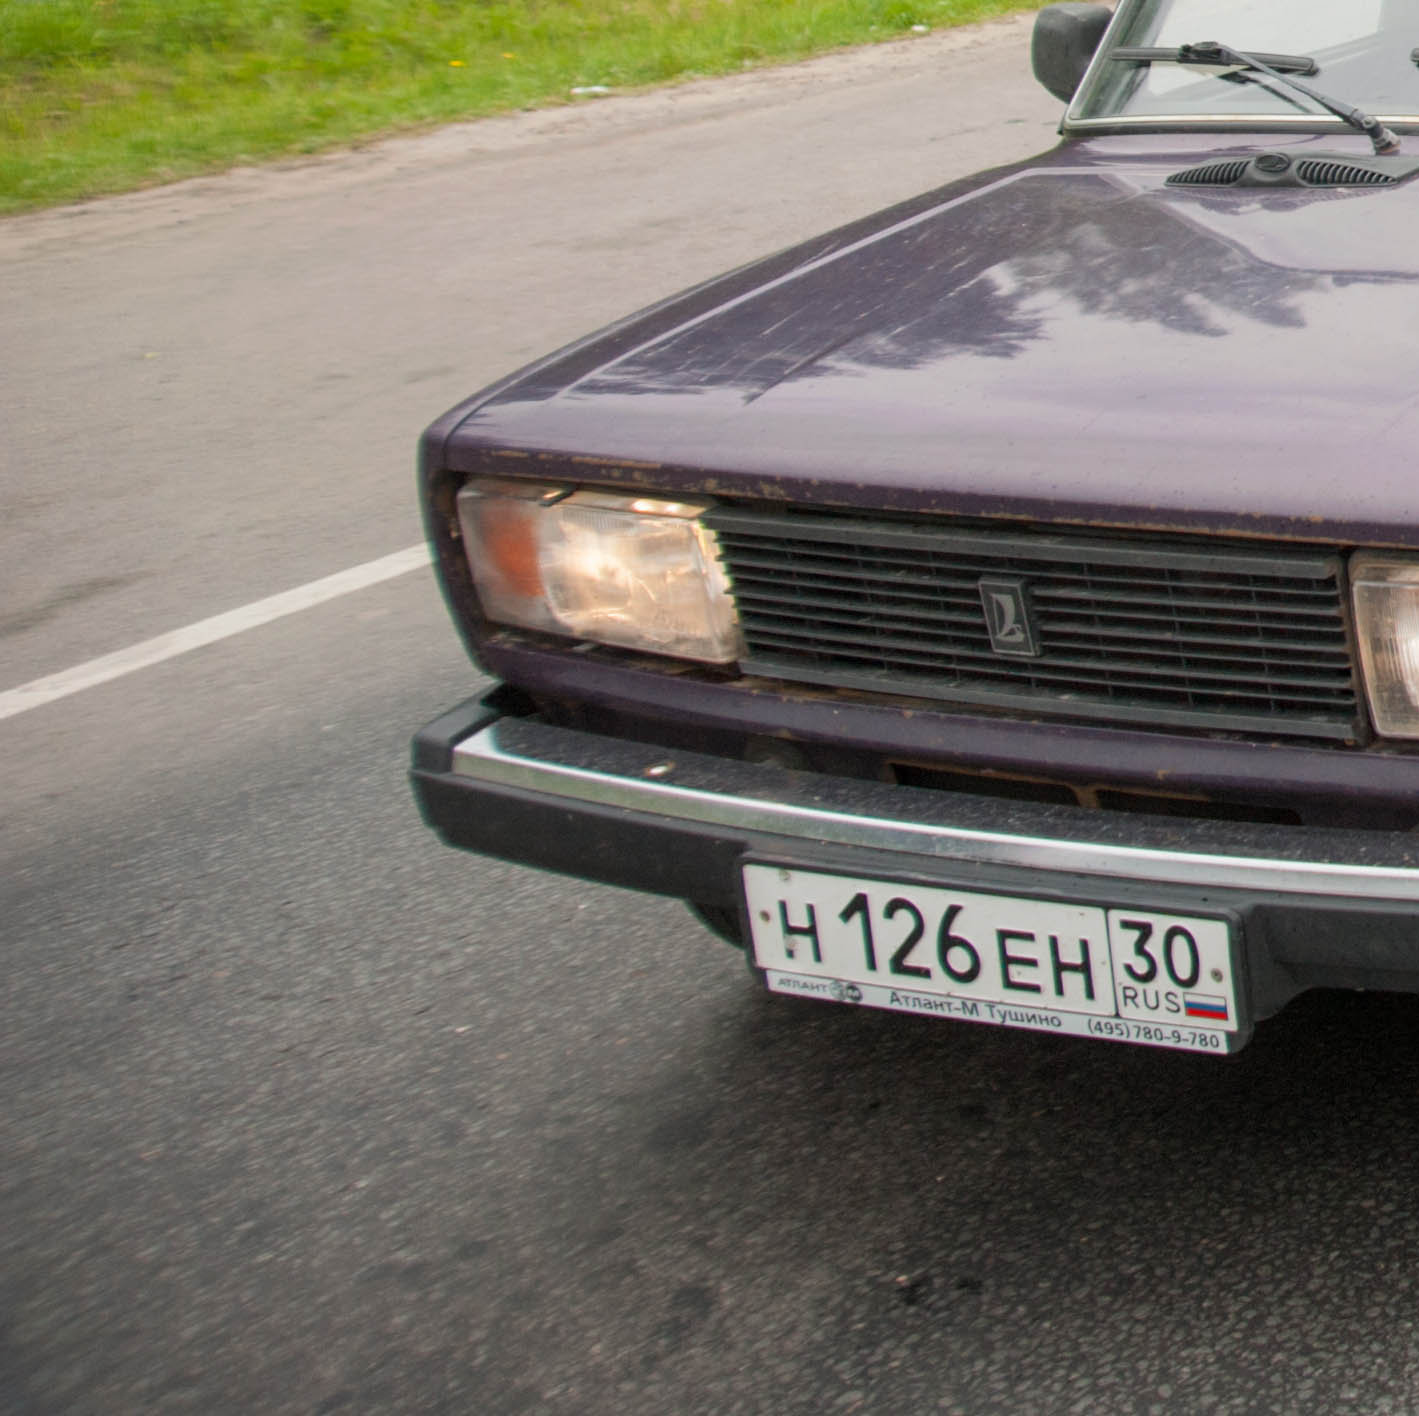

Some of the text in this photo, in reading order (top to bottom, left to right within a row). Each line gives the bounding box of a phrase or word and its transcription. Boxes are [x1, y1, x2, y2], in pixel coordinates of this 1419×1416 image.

[1119, 918, 1200, 989] 30
[889, 990, 1062, 1028] Атлант-М Тушино
[1122, 985, 1181, 1014] RUS
